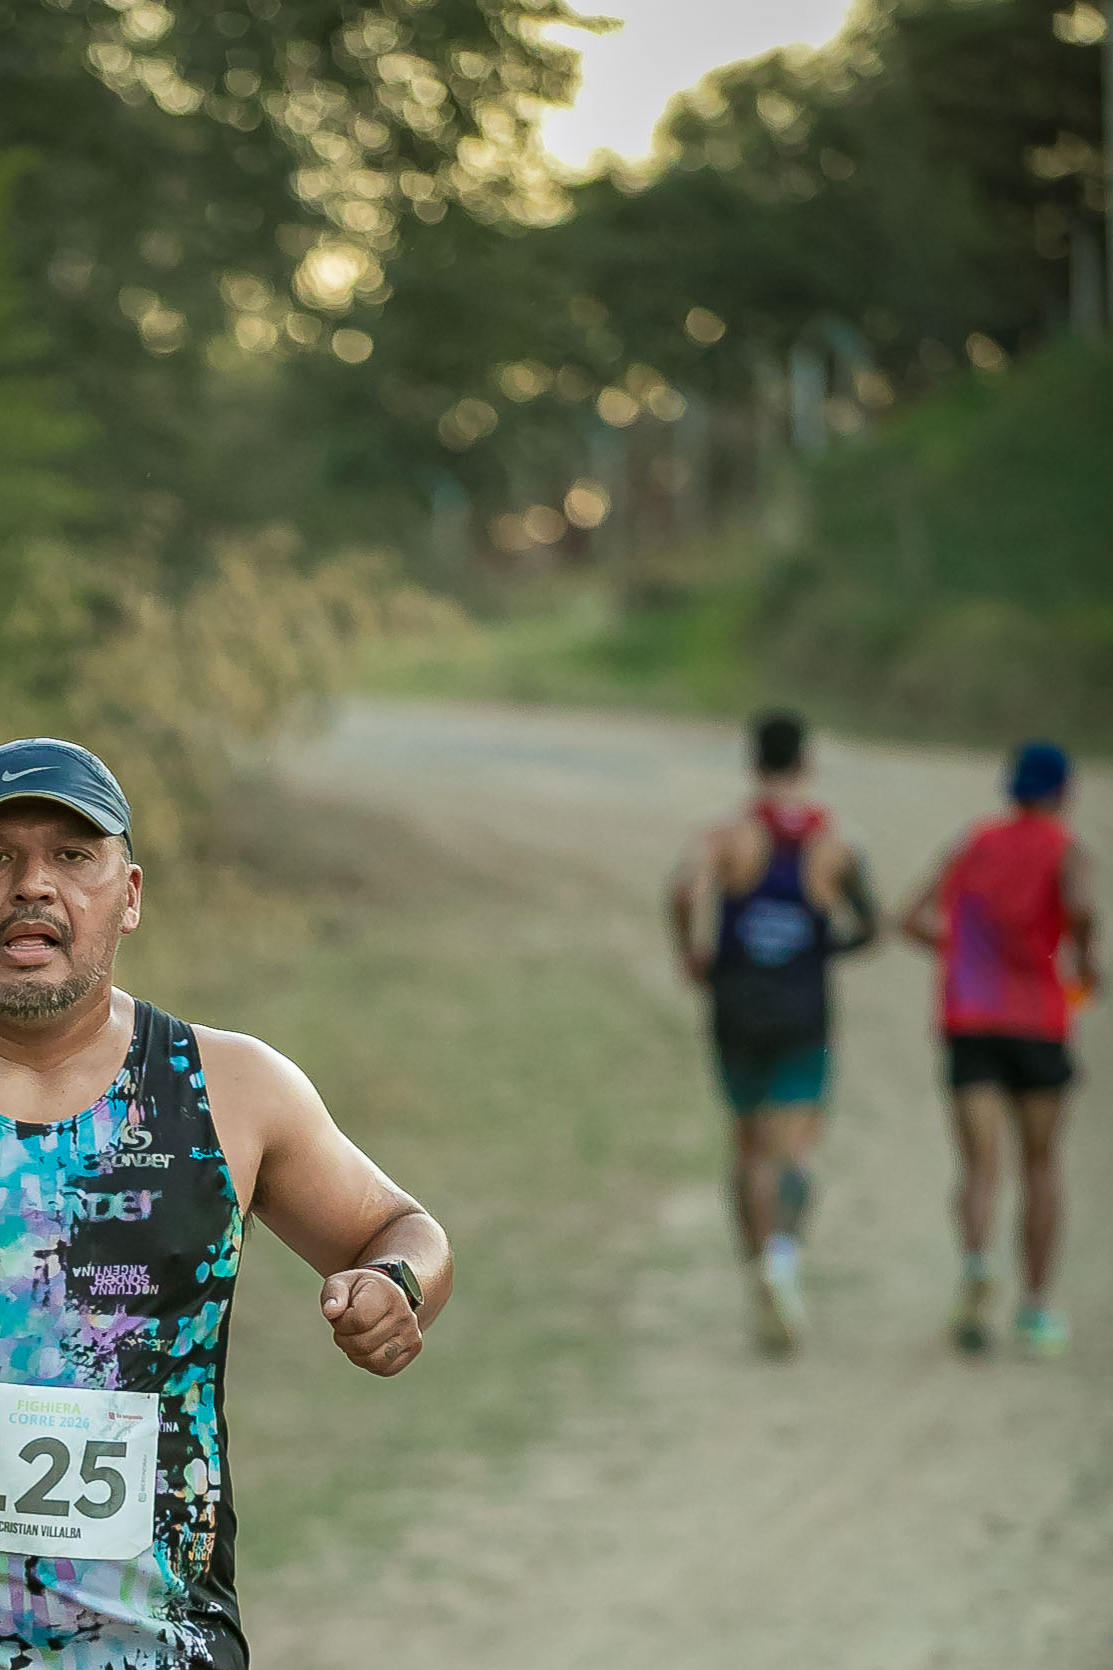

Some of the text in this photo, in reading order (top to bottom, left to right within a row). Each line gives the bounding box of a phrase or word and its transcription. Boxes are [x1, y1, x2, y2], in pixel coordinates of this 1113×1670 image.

[72, 1264, 148, 1278] ARGENTINA
[17, 1400, 81, 1414] FIGHIERA
[9, 1412, 90, 1429] CORRE 2026
[41, 1525, 81, 1539] VILLALBA
